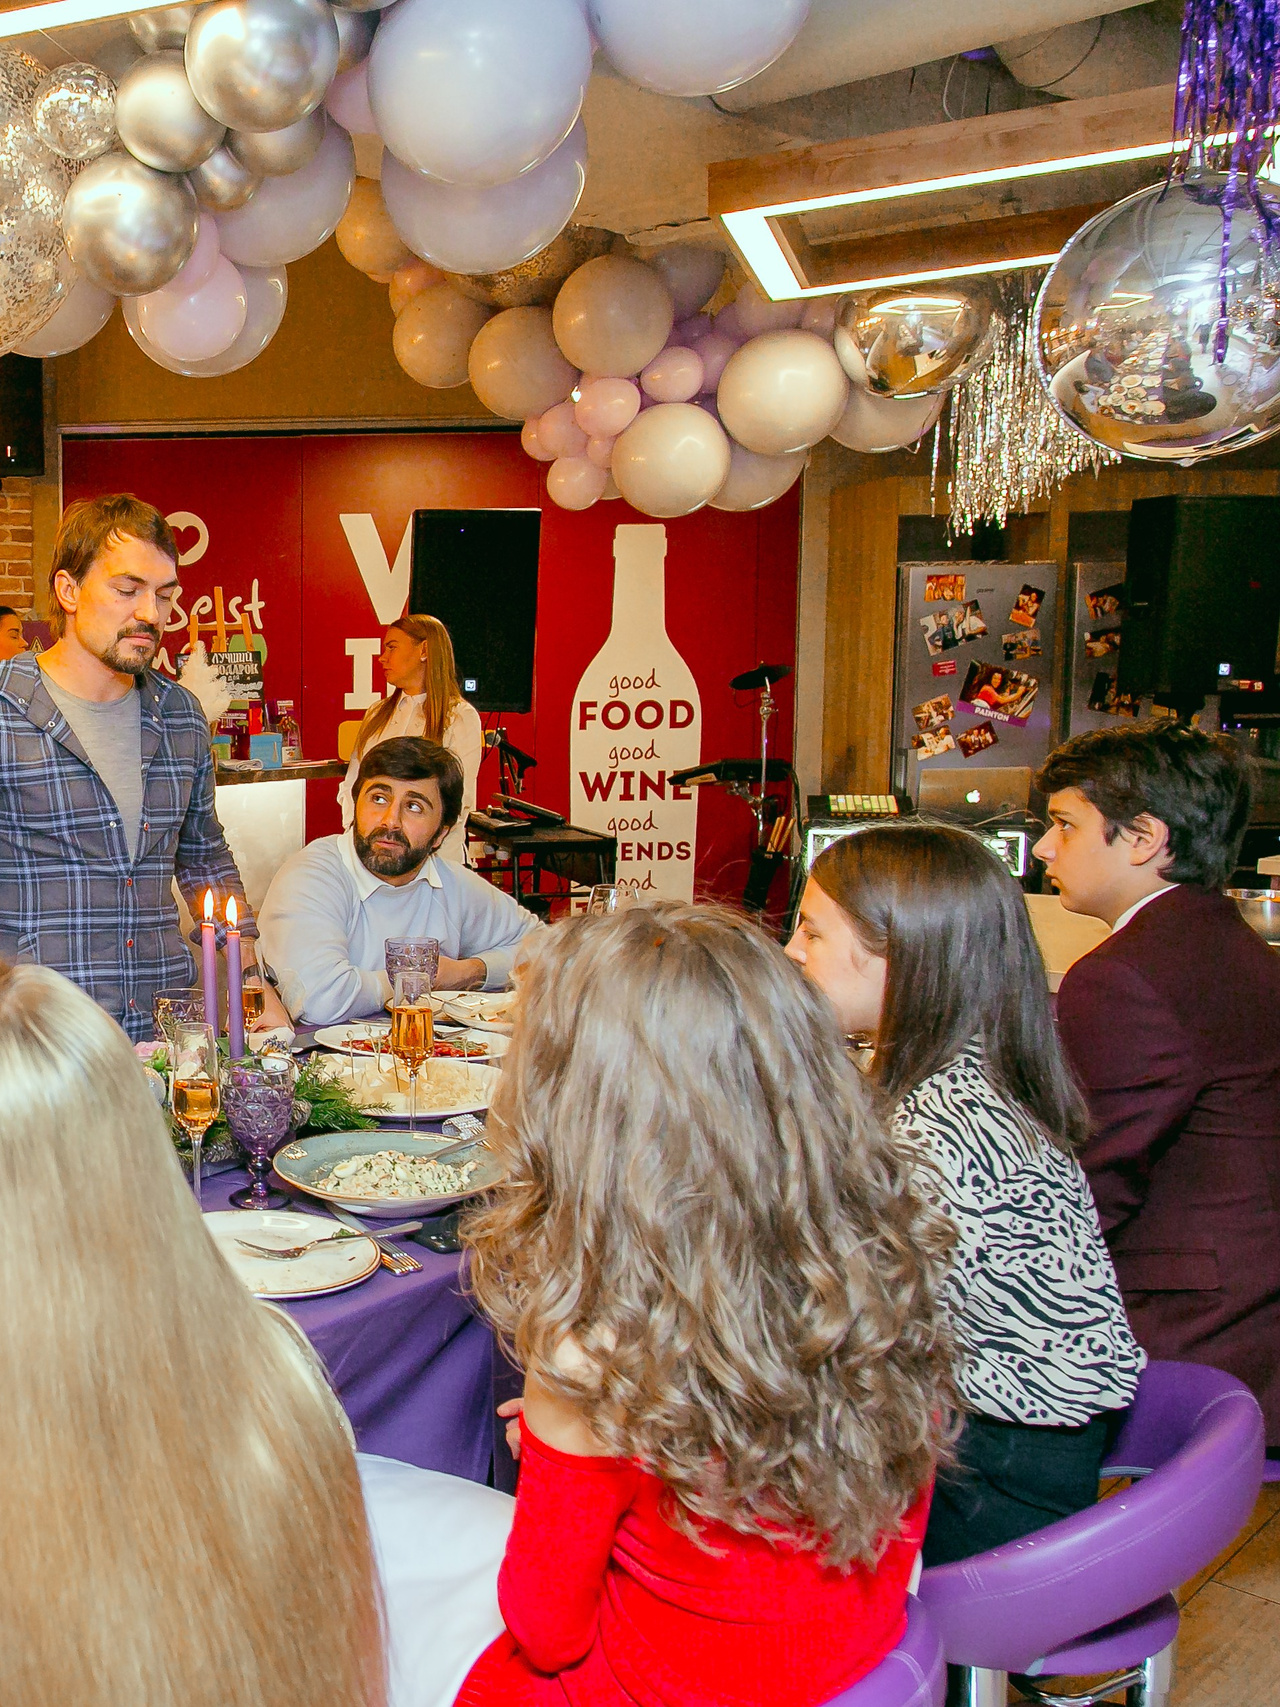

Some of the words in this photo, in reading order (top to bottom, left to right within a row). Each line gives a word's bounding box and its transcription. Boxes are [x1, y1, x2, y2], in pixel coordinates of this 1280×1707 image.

[211, 651, 253, 664] ЛУЧШИЙ
[217, 663, 260, 676] ОДАРОК
[608, 668, 662, 698] good
[578, 700, 695, 731] FOOD
[608, 739, 661, 769] good
[578, 770, 694, 802] WINE
[606, 810, 660, 837] good
[617, 841, 692, 862] ENDS
